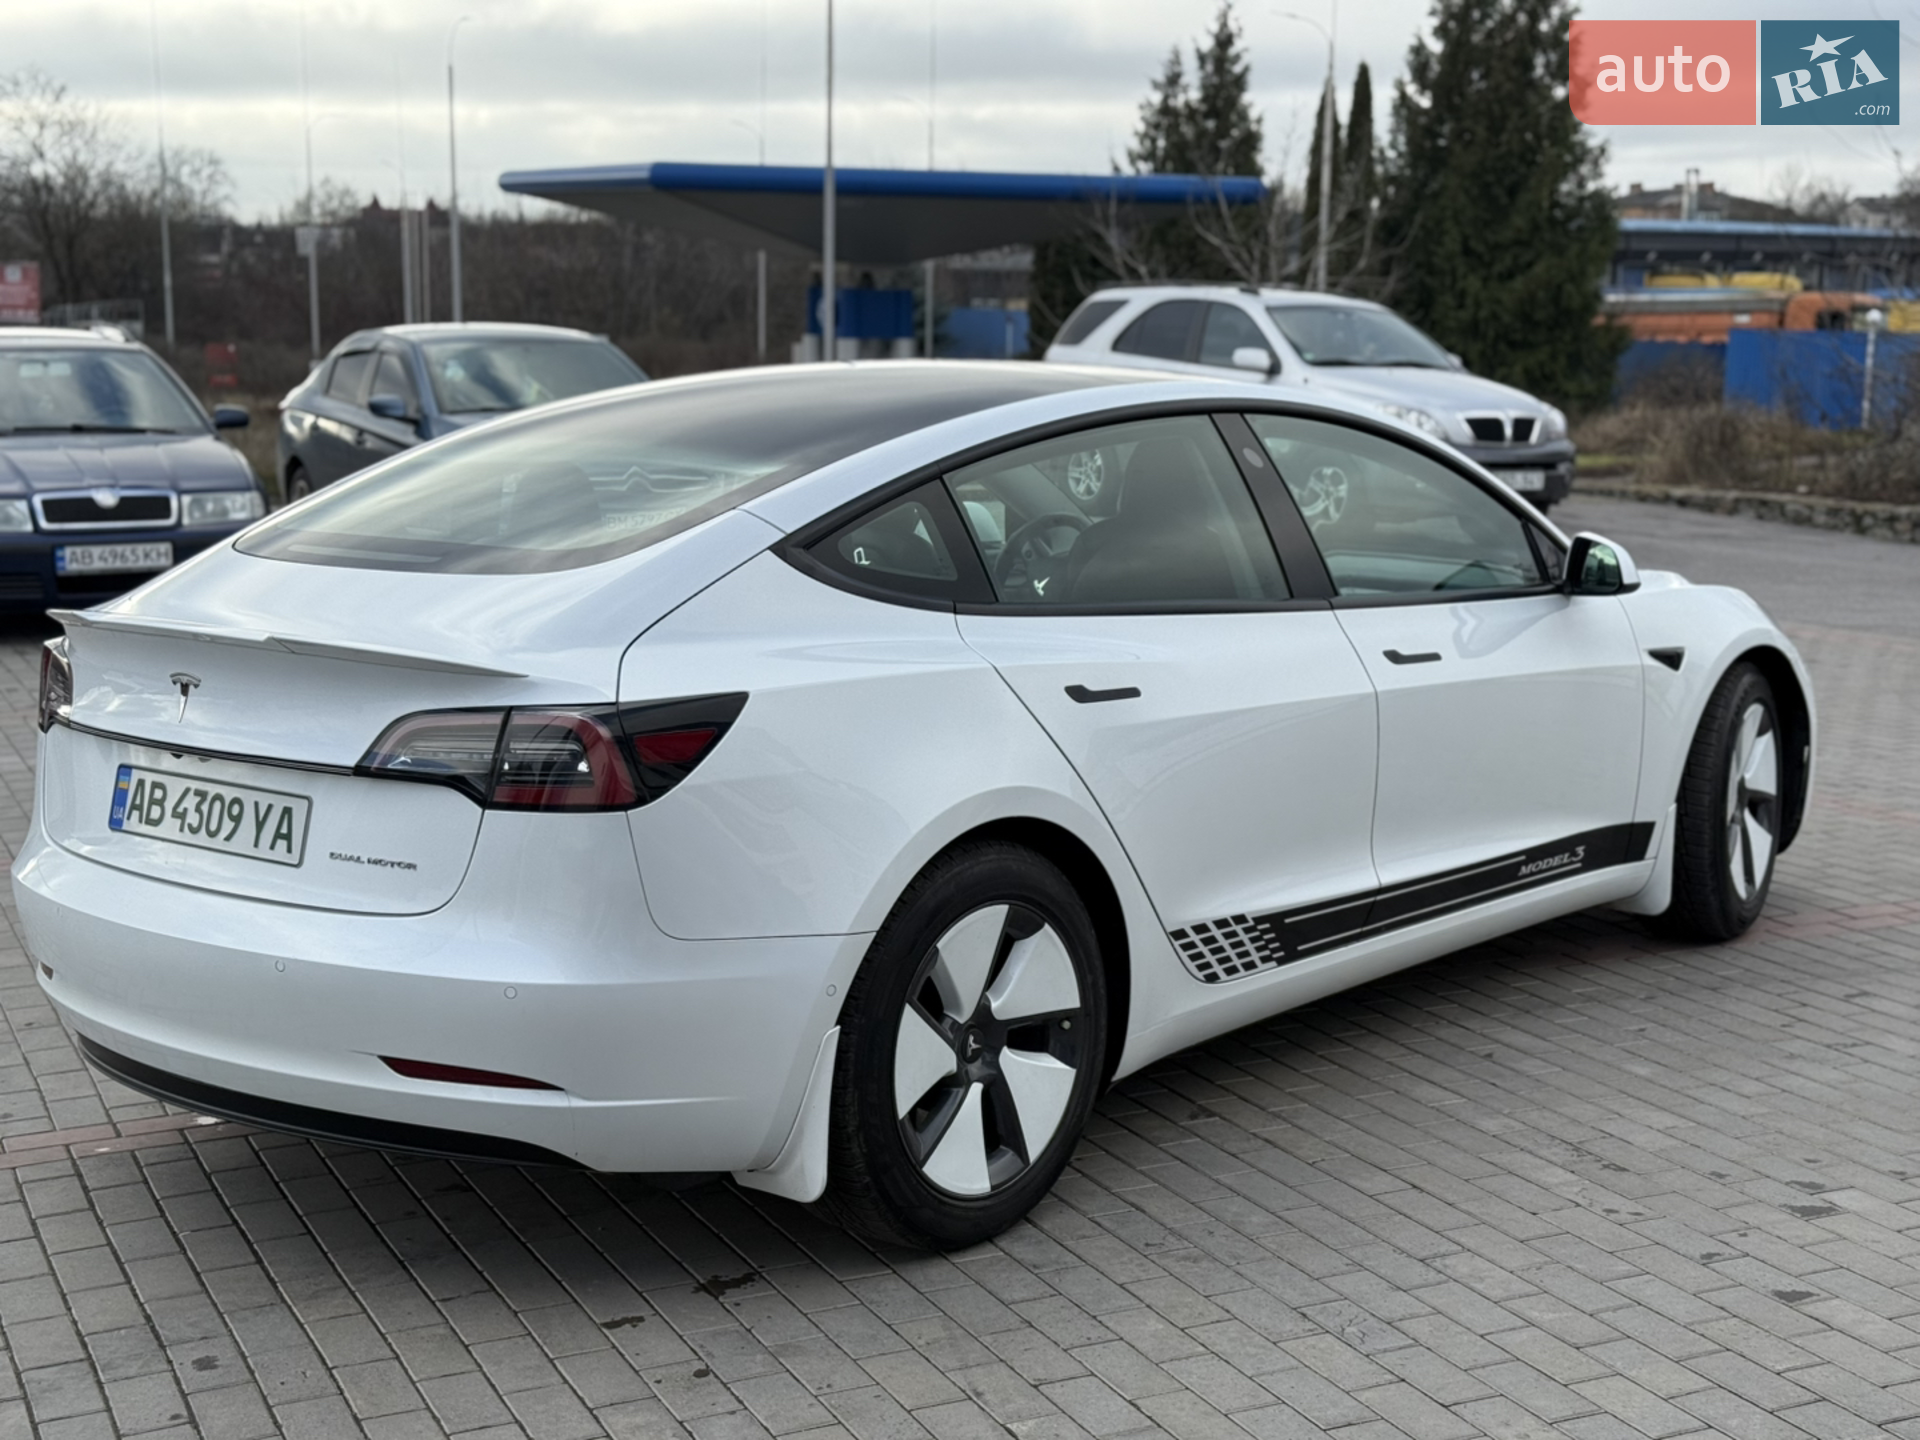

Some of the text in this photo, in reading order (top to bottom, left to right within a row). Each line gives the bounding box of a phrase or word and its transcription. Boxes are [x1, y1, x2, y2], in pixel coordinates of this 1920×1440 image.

[607, 513, 627, 530] BM
[68, 549, 94, 566] AB
[98, 547, 140, 564] 4965
[142, 546, 170, 562] KH
[126, 778, 293, 854] AB 4309 YA
[329, 852, 418, 870] DUAL MOTOR
